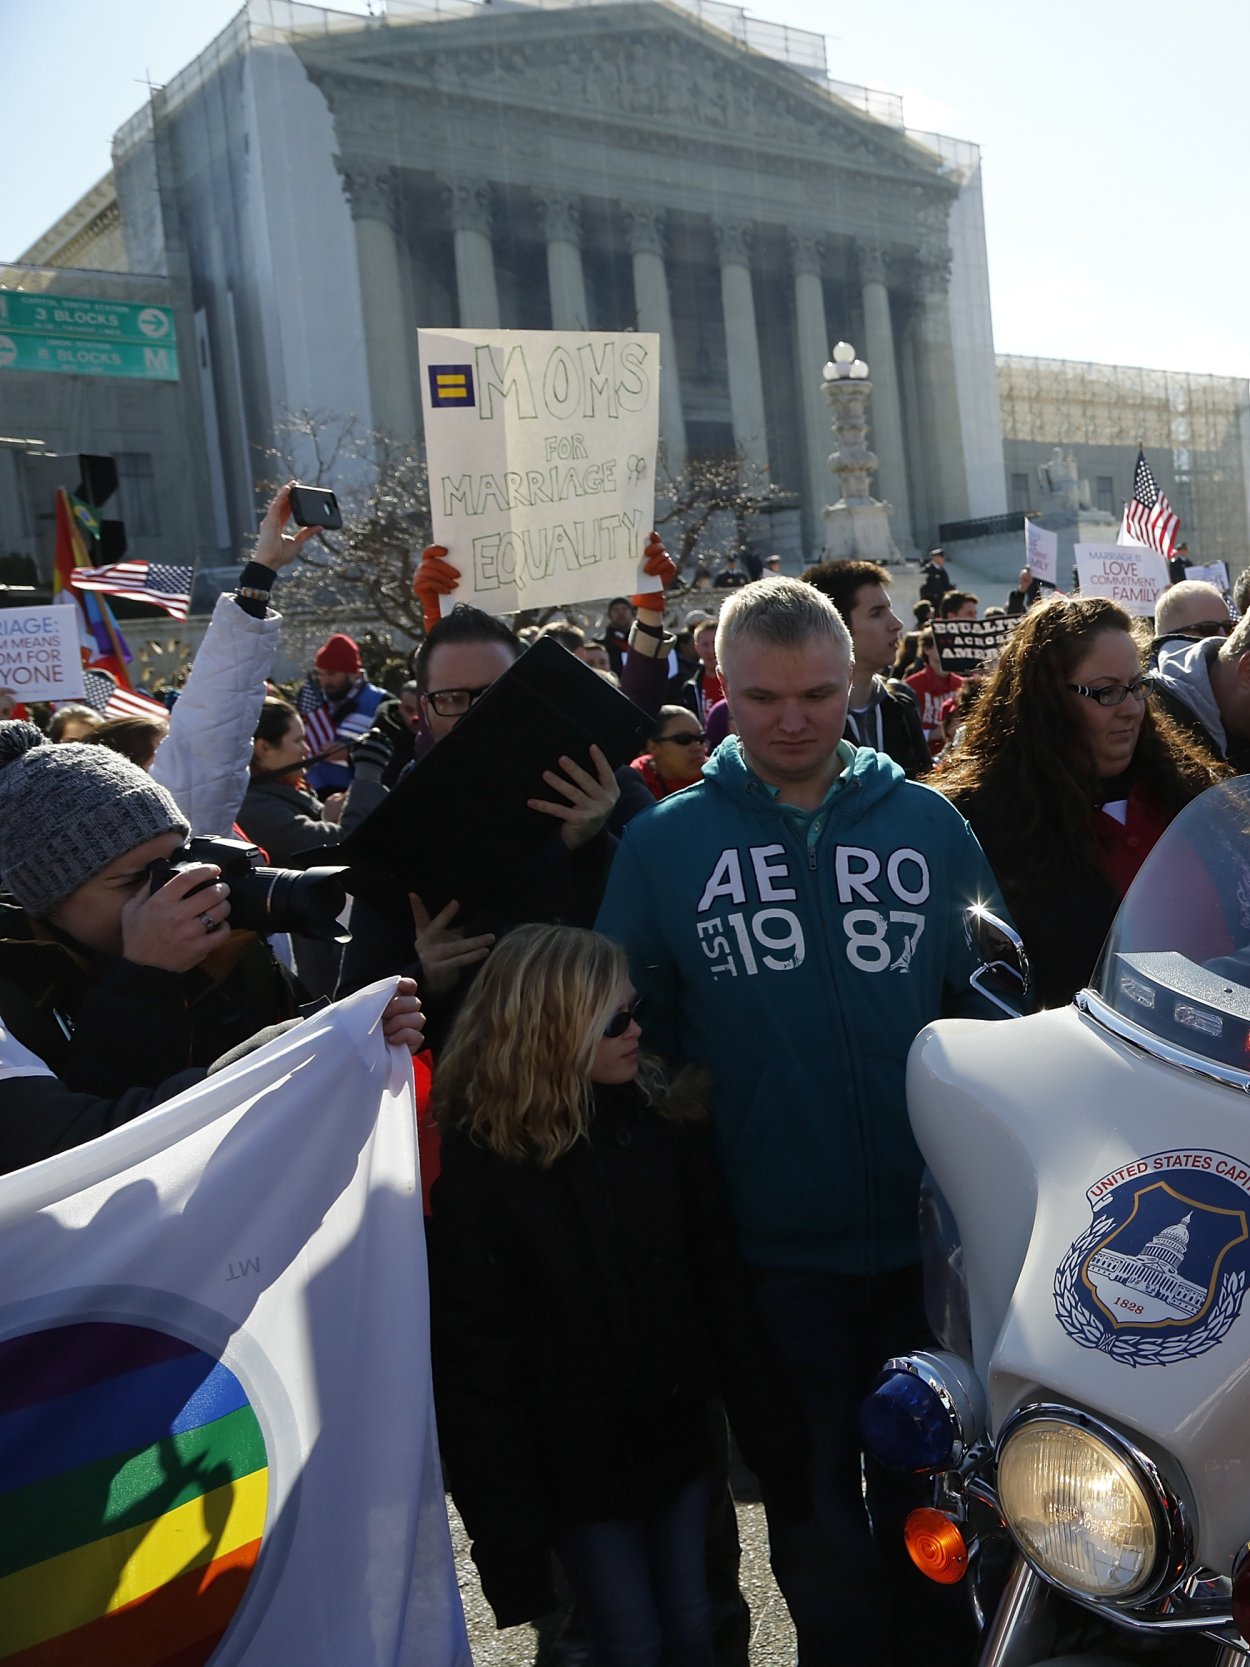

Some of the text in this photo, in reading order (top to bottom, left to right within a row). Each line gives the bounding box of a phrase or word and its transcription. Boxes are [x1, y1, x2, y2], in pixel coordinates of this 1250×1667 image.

[35, 308, 119, 327] 3 BLOCKS
[57, 350, 122, 366] BLOCKS
[475, 341, 649, 420] MOMS
[545, 433, 588, 462] FOR
[442, 459, 617, 516] MARRIAGE
[472, 508, 643, 592] EQUALITY
[1103, 560, 1138, 576] LOVE
[1090, 574, 1156, 587] COMMITMENT
[1112, 586, 1160, 602] FAMILY
[932, 618, 1018, 635] EQUALIT
[11, 636, 61, 649] MEANS
[954, 634, 1006, 647] ACROS
[27, 649, 62, 664] FOR
[941, 647, 998, 661] AMER
[697, 917, 738, 981] EST.
[1090, 1162, 1148, 1198] UNITED
[1153, 1154, 1212, 1170] STATES
[1114, 1297, 1144, 1315] 1828
